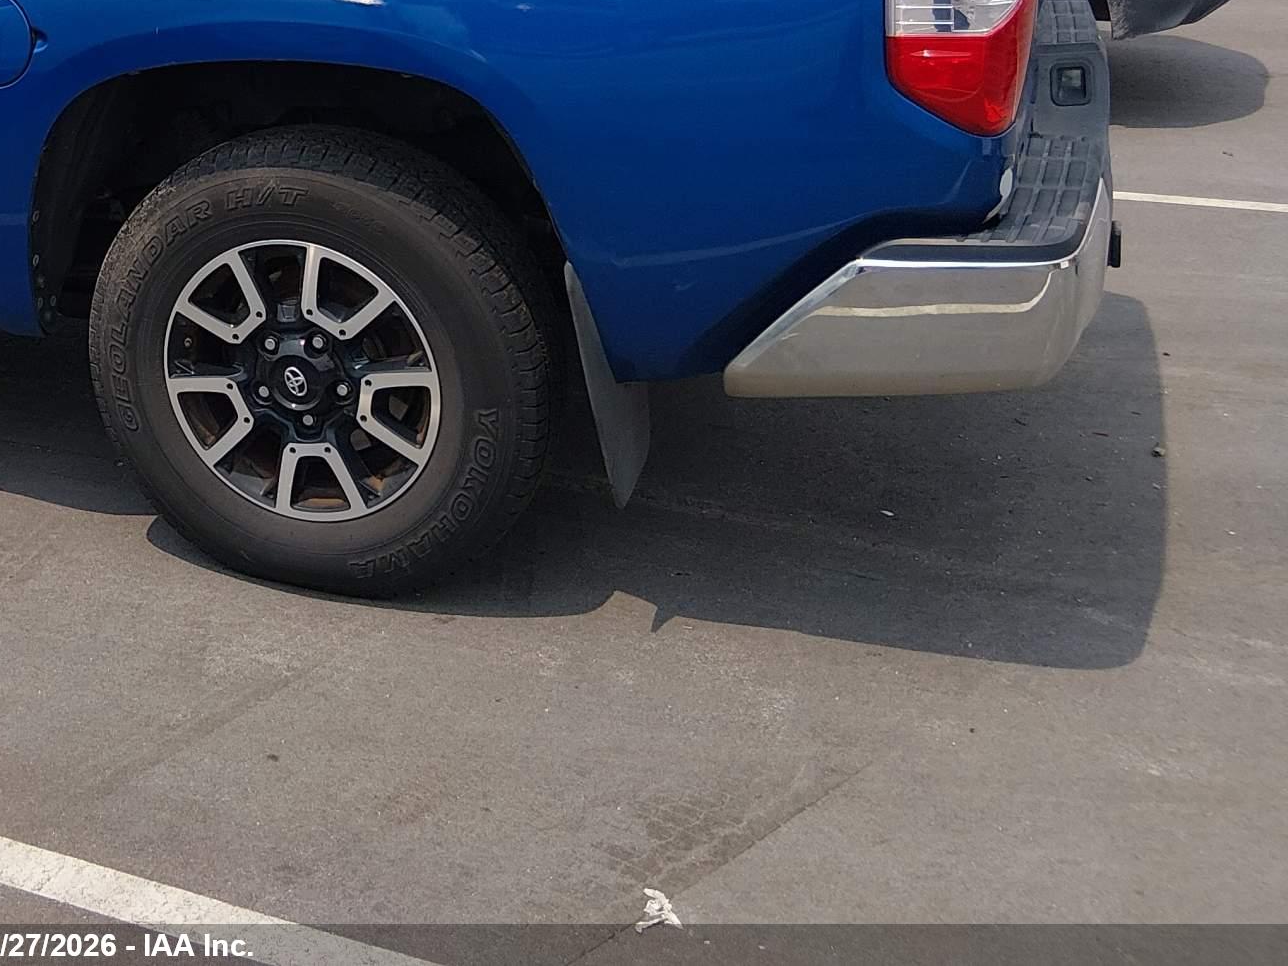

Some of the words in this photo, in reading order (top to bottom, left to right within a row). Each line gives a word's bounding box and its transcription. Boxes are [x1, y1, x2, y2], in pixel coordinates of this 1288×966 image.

[109, 200, 212, 430] GEOLANDAR
[224, 186, 310, 211] H/T
[348, 408, 499, 578] YOKOHAMA
